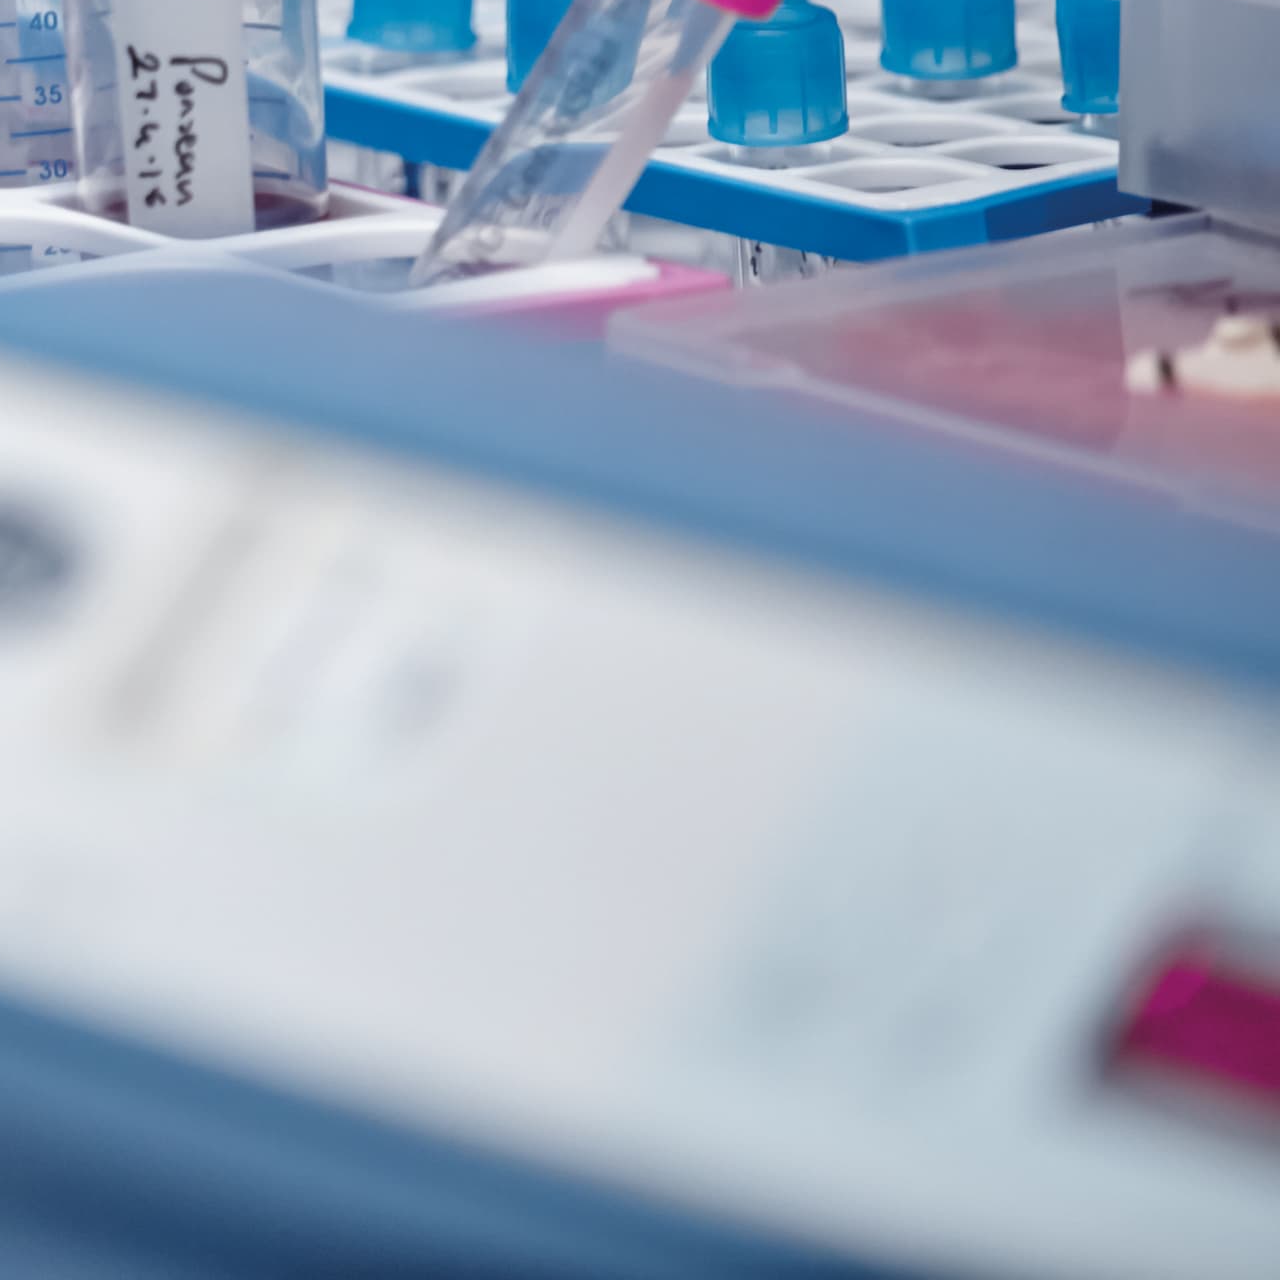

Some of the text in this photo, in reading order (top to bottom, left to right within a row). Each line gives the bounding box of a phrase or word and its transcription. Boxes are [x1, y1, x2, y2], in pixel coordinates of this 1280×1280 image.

[28, 10, 59, 31] 40
[33, 83, 64, 106] 35
[38, 158, 69, 181] 30
